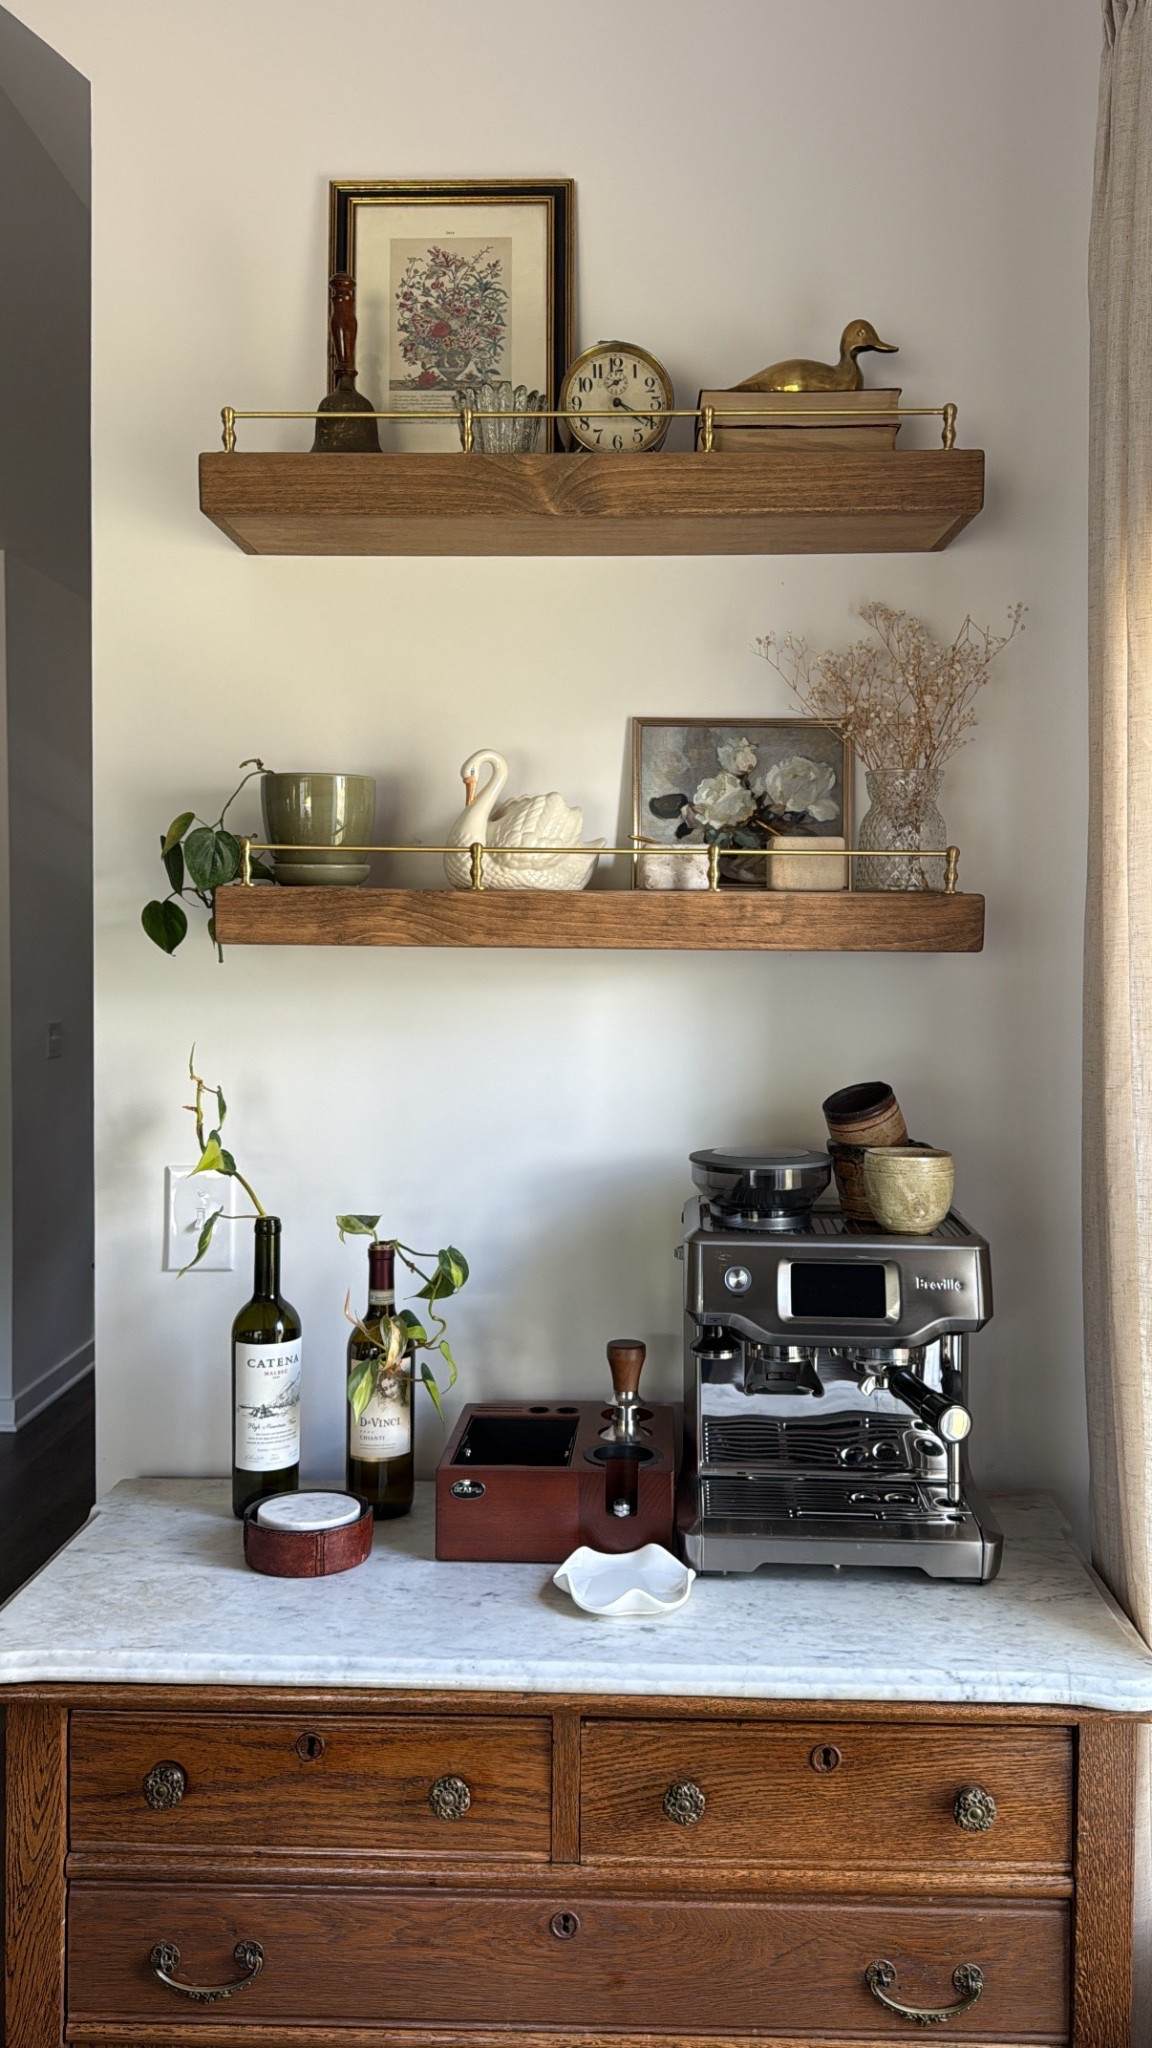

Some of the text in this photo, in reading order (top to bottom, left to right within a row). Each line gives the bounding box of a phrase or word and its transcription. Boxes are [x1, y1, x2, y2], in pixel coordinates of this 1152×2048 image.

[592, 364, 602, 378] 11
[610, 358, 624, 372] 12
[632, 364, 637, 378] 1
[578, 376, 593, 392] 10
[644, 376, 656, 393] 2
[572, 396, 582, 412] 9
[580, 416, 590, 432] 8
[593, 428, 603, 444] 7
[612, 434, 623, 450] 6
[632, 428, 643, 444] 5
[916, 1276, 961, 1291] Breville
[246, 1354, 299, 1368] CATENA
